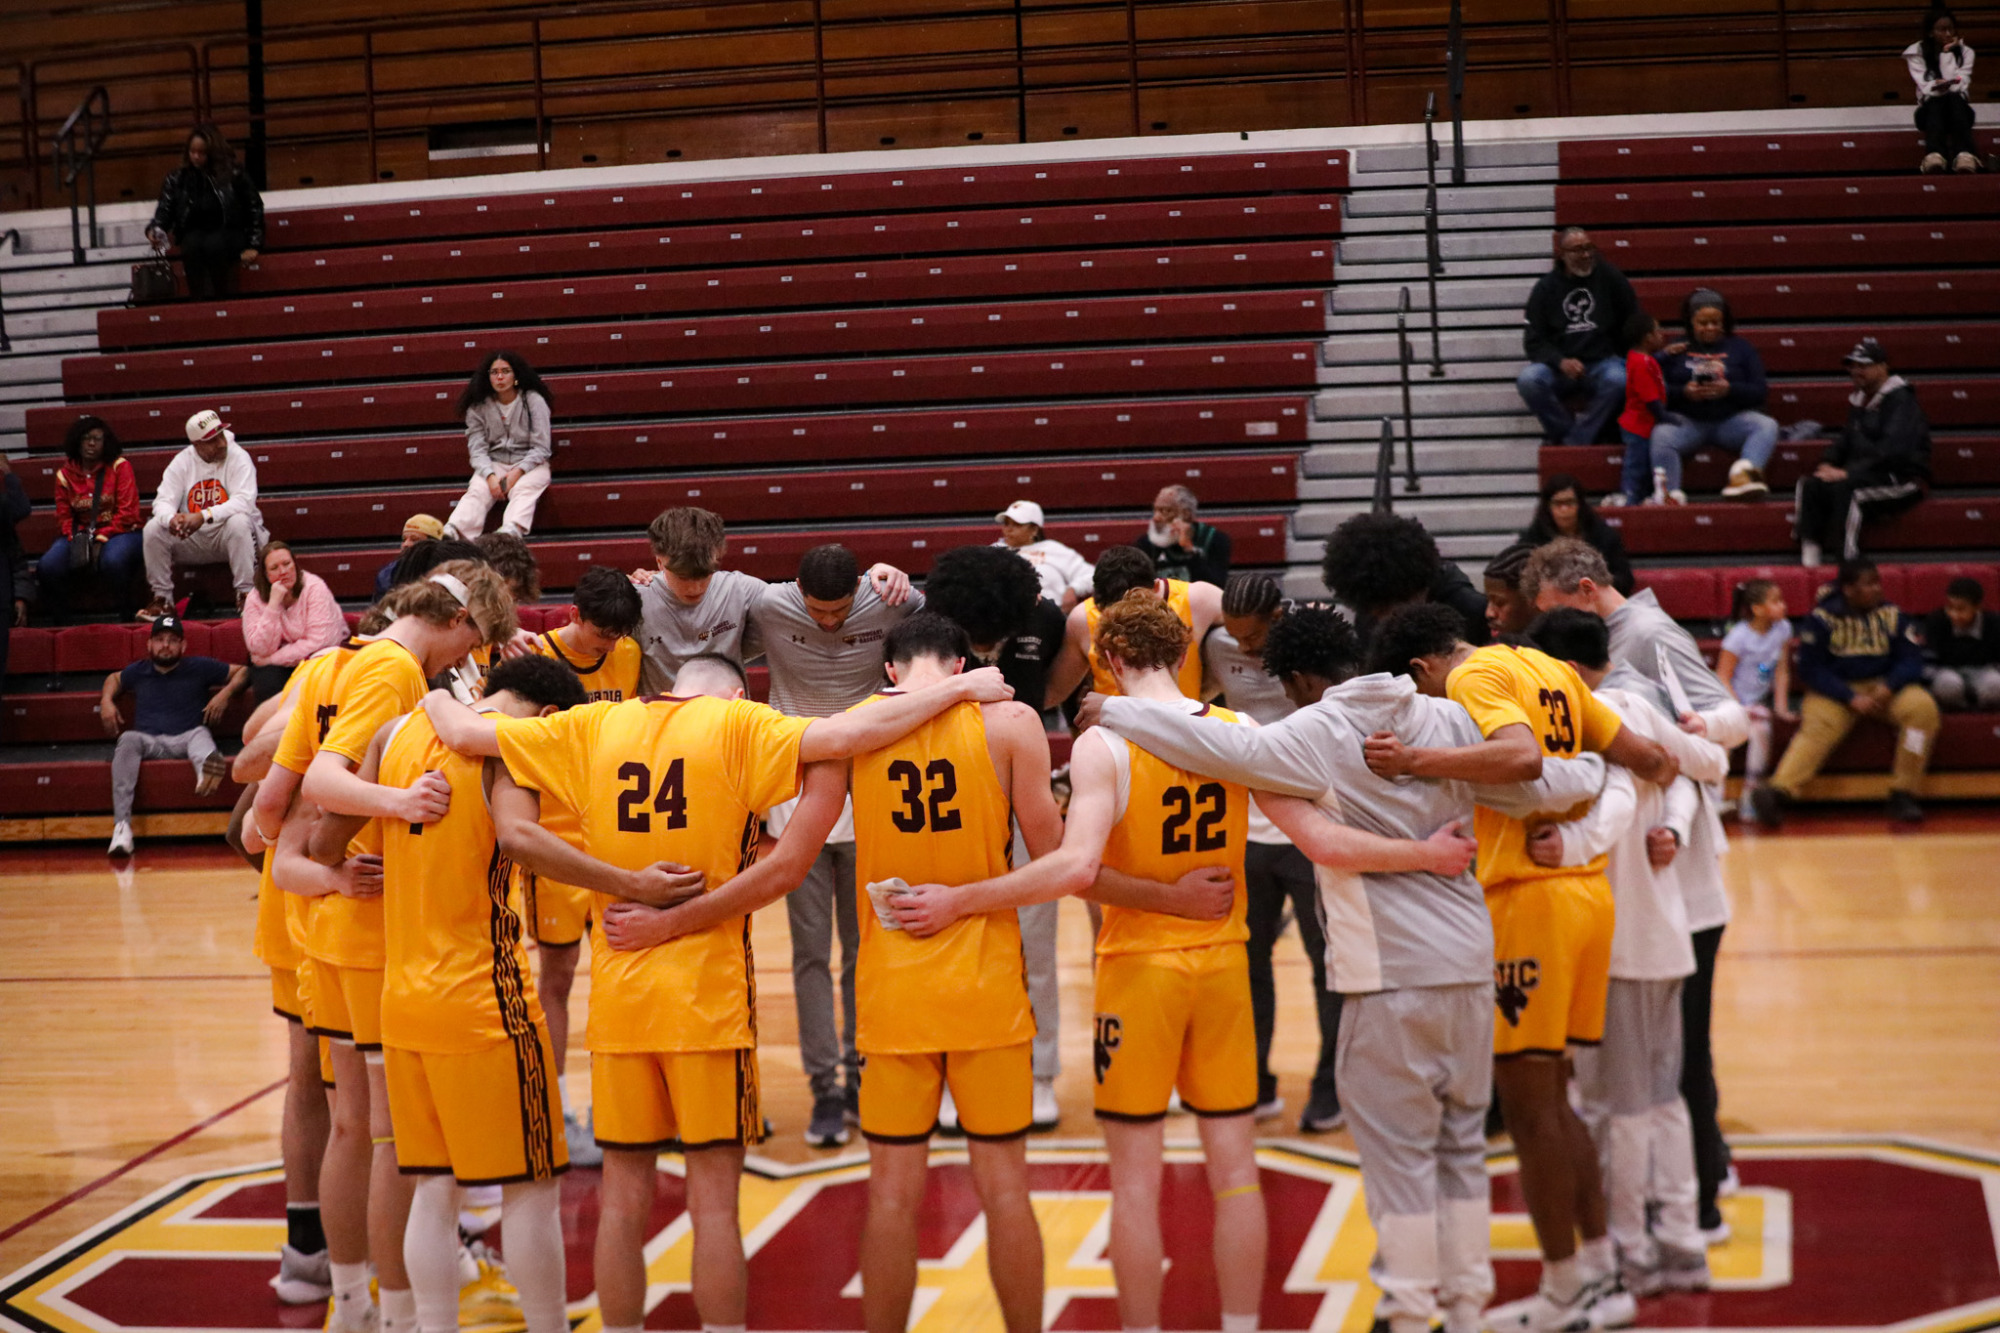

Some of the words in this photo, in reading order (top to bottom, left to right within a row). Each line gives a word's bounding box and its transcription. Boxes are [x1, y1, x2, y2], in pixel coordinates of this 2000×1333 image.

[1539, 688, 1575, 752] 33
[618, 758, 687, 832] 24
[888, 759, 961, 833] 32
[1161, 782, 1227, 856] 22
